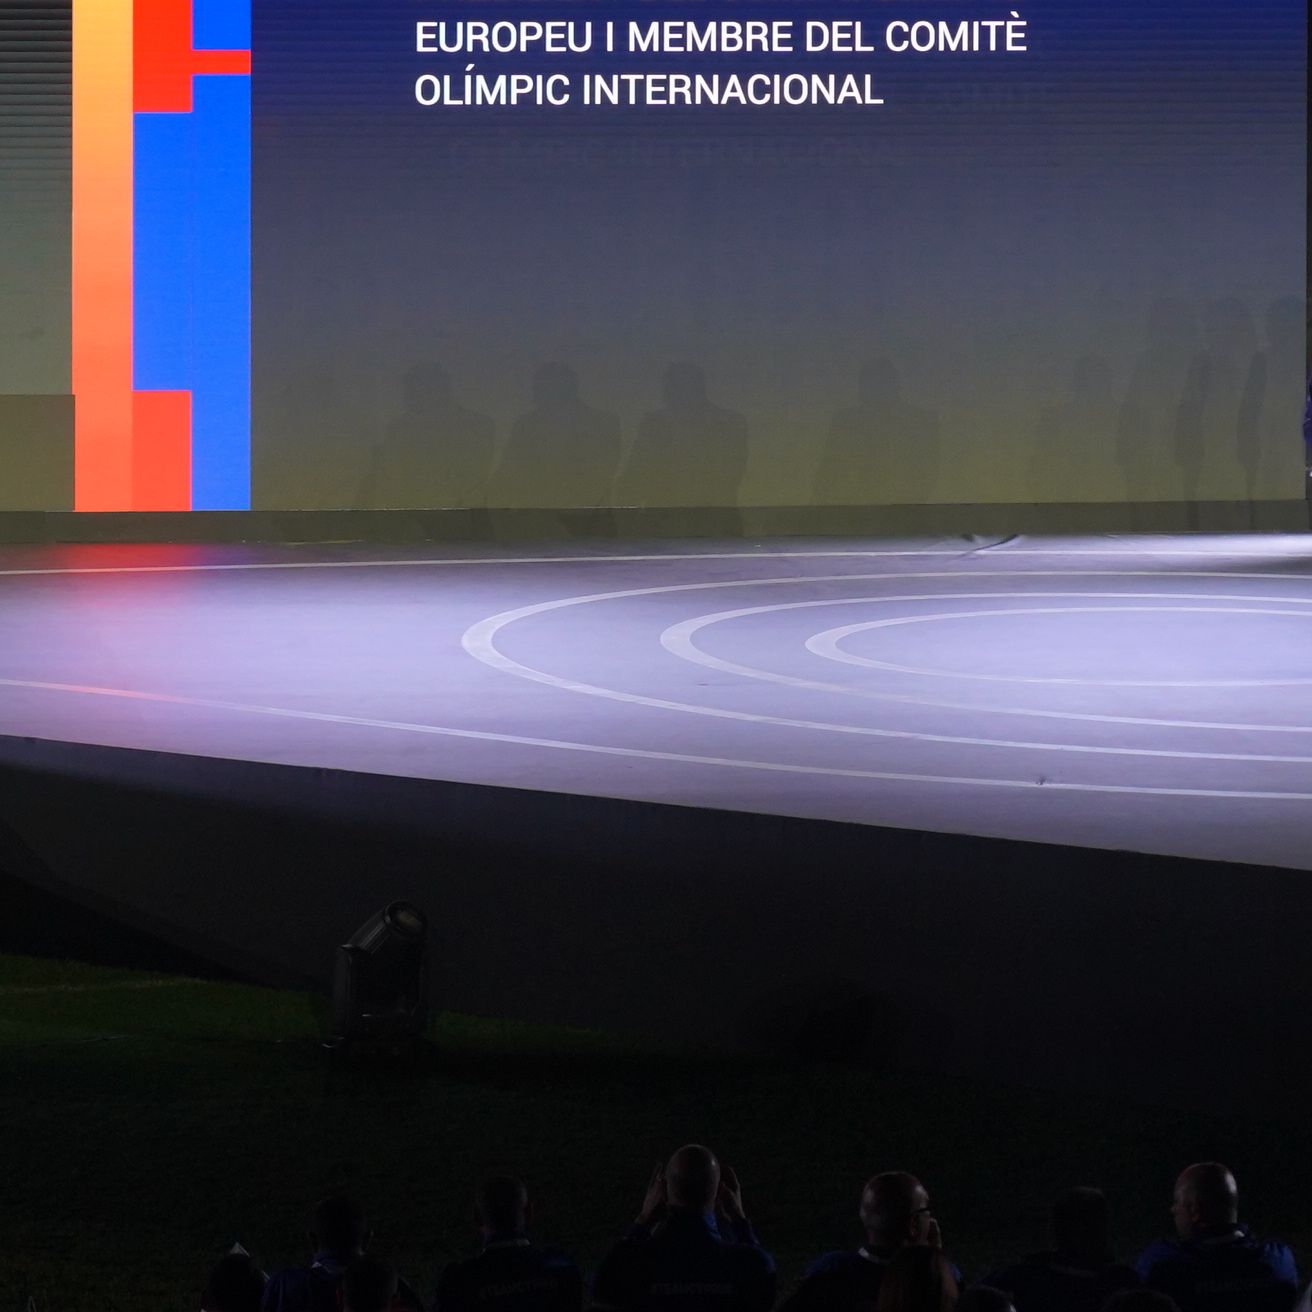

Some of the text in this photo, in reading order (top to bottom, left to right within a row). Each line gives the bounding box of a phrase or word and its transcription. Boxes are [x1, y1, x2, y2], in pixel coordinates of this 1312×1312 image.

[416, 10, 1027, 52] EUROPEU I MEMBRE DEL COMITÈ
[415, 63, 884, 105] OLÍMPIC INTERNACIONAL
